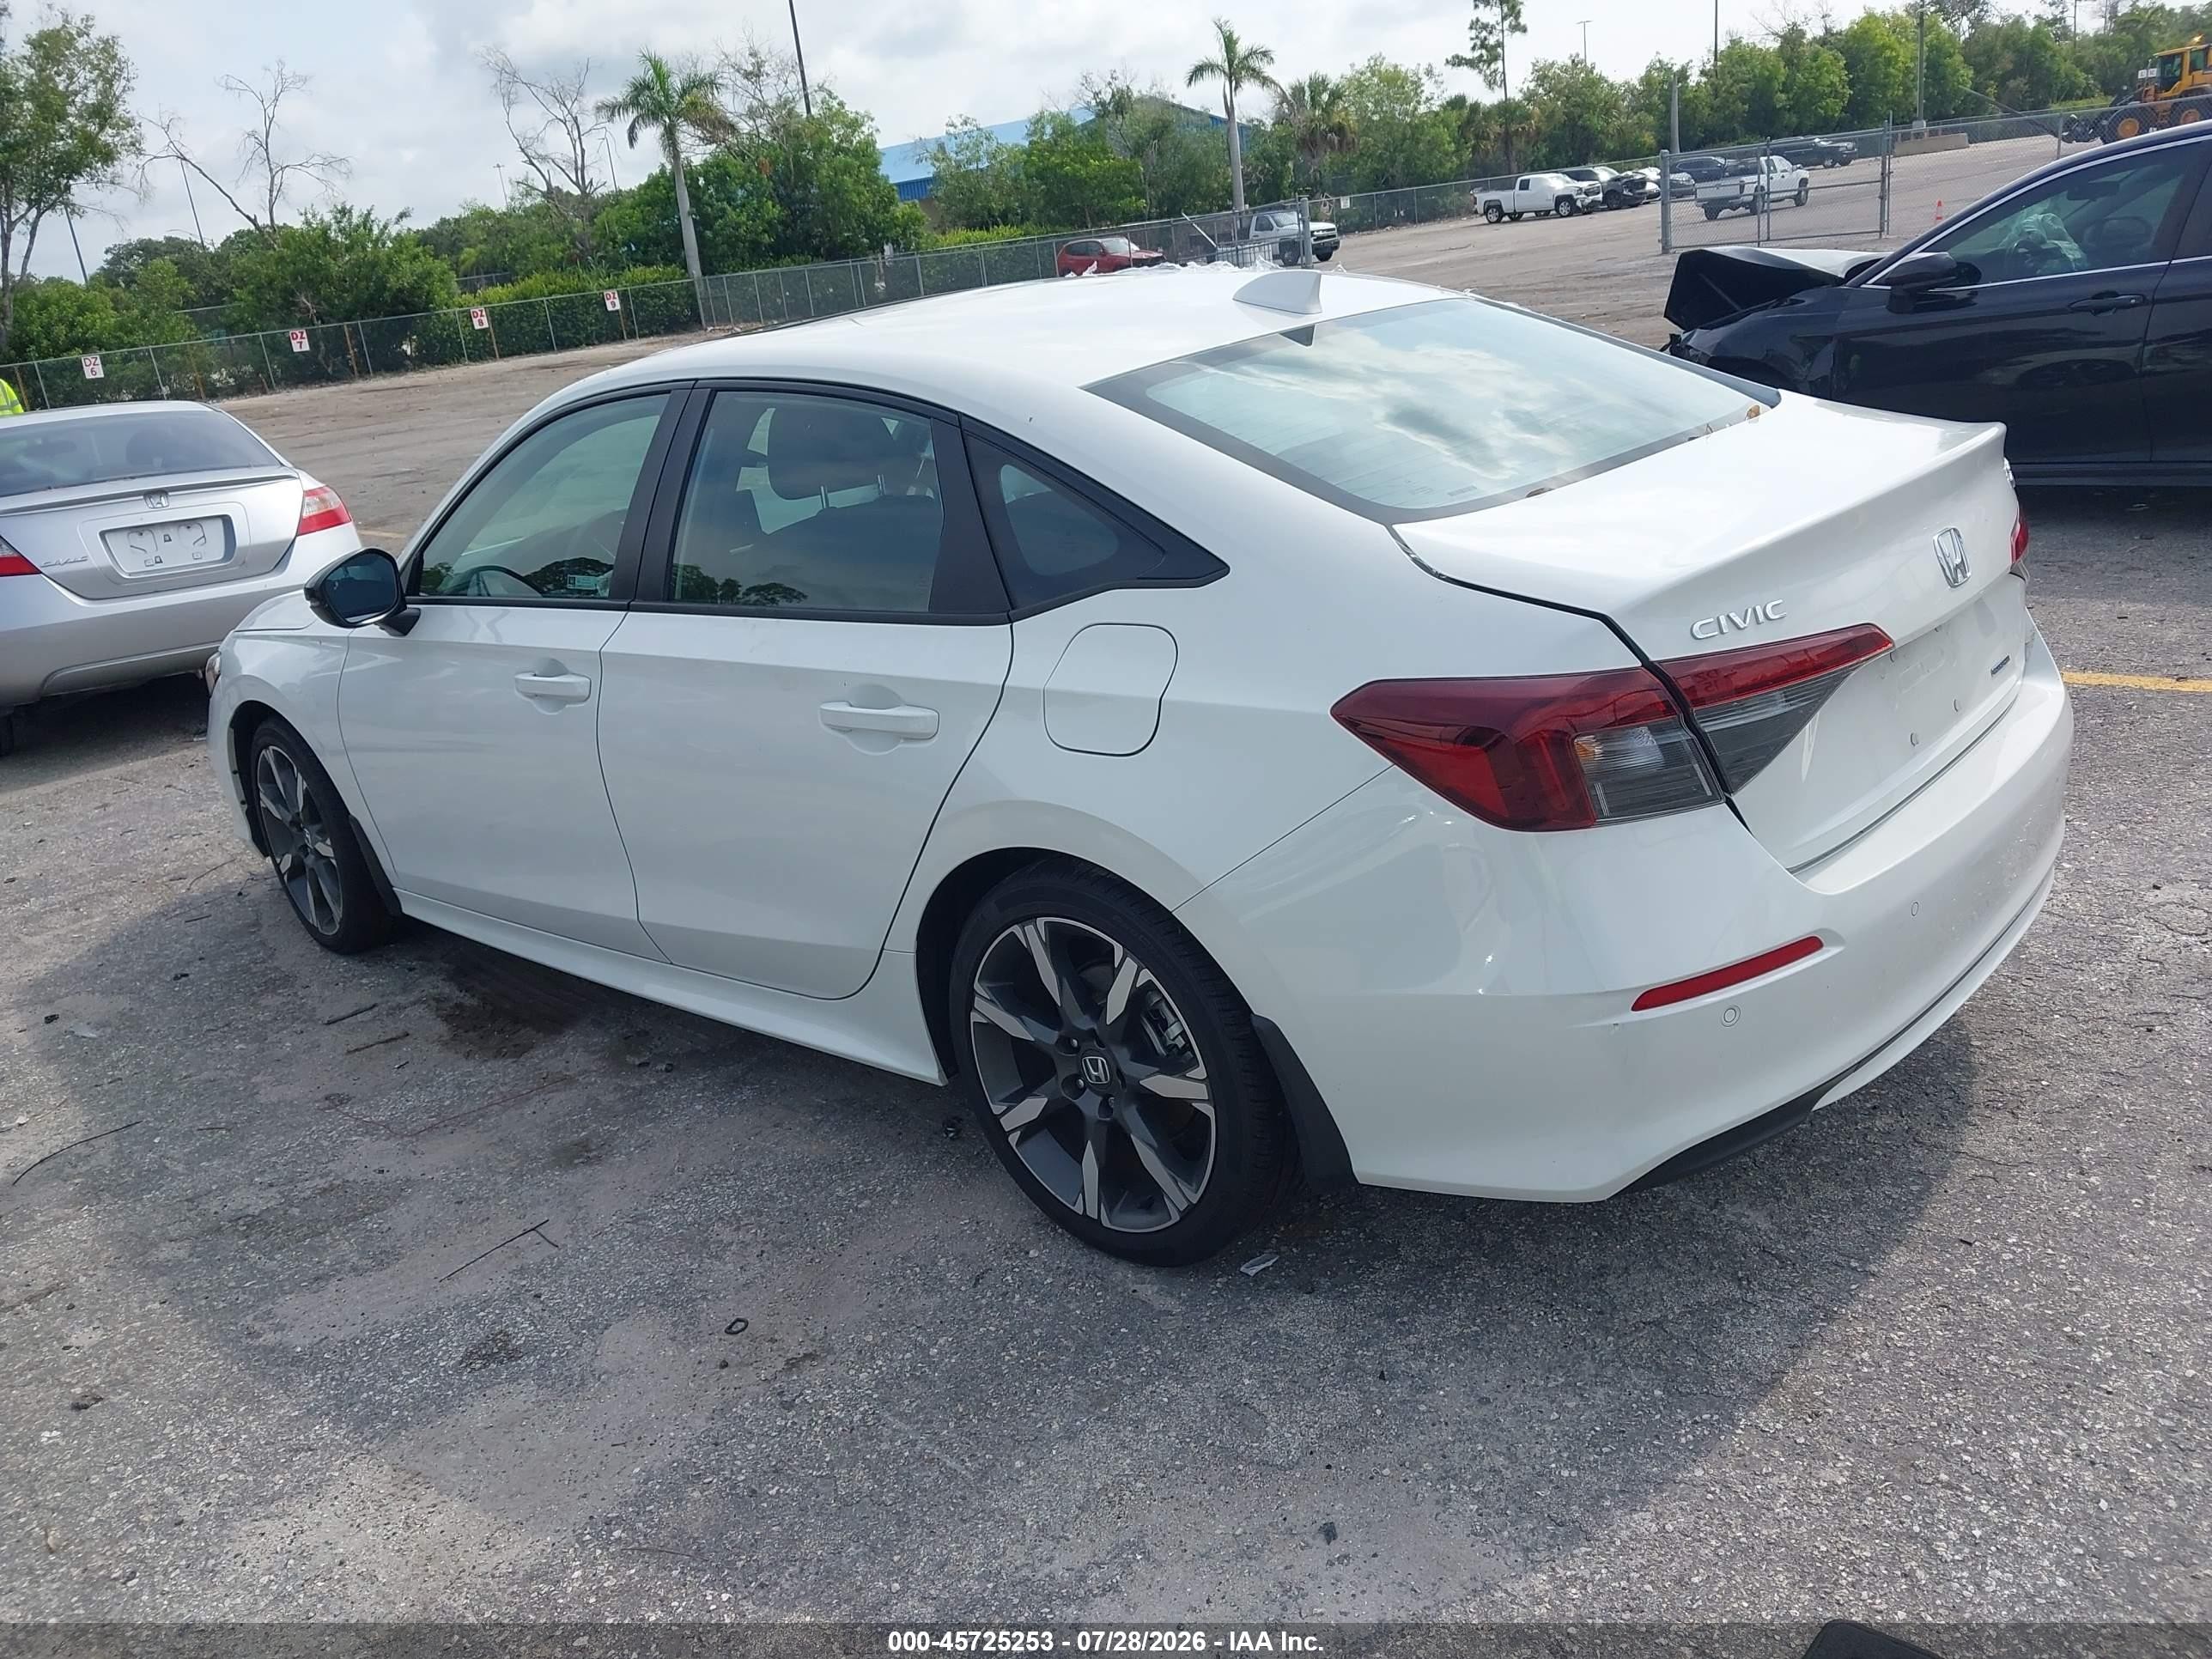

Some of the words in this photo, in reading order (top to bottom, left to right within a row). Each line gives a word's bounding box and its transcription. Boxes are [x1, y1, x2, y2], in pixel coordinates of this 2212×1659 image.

[605, 292, 617, 301] DZ
[472, 309, 485, 319] DZ
[291, 331, 306, 341] DZ
[296, 341, 303, 349] 7
[83, 356, 100, 368] DZ
[90, 367, 97, 376] 6
[1690, 599, 1787, 641] CIVIC
